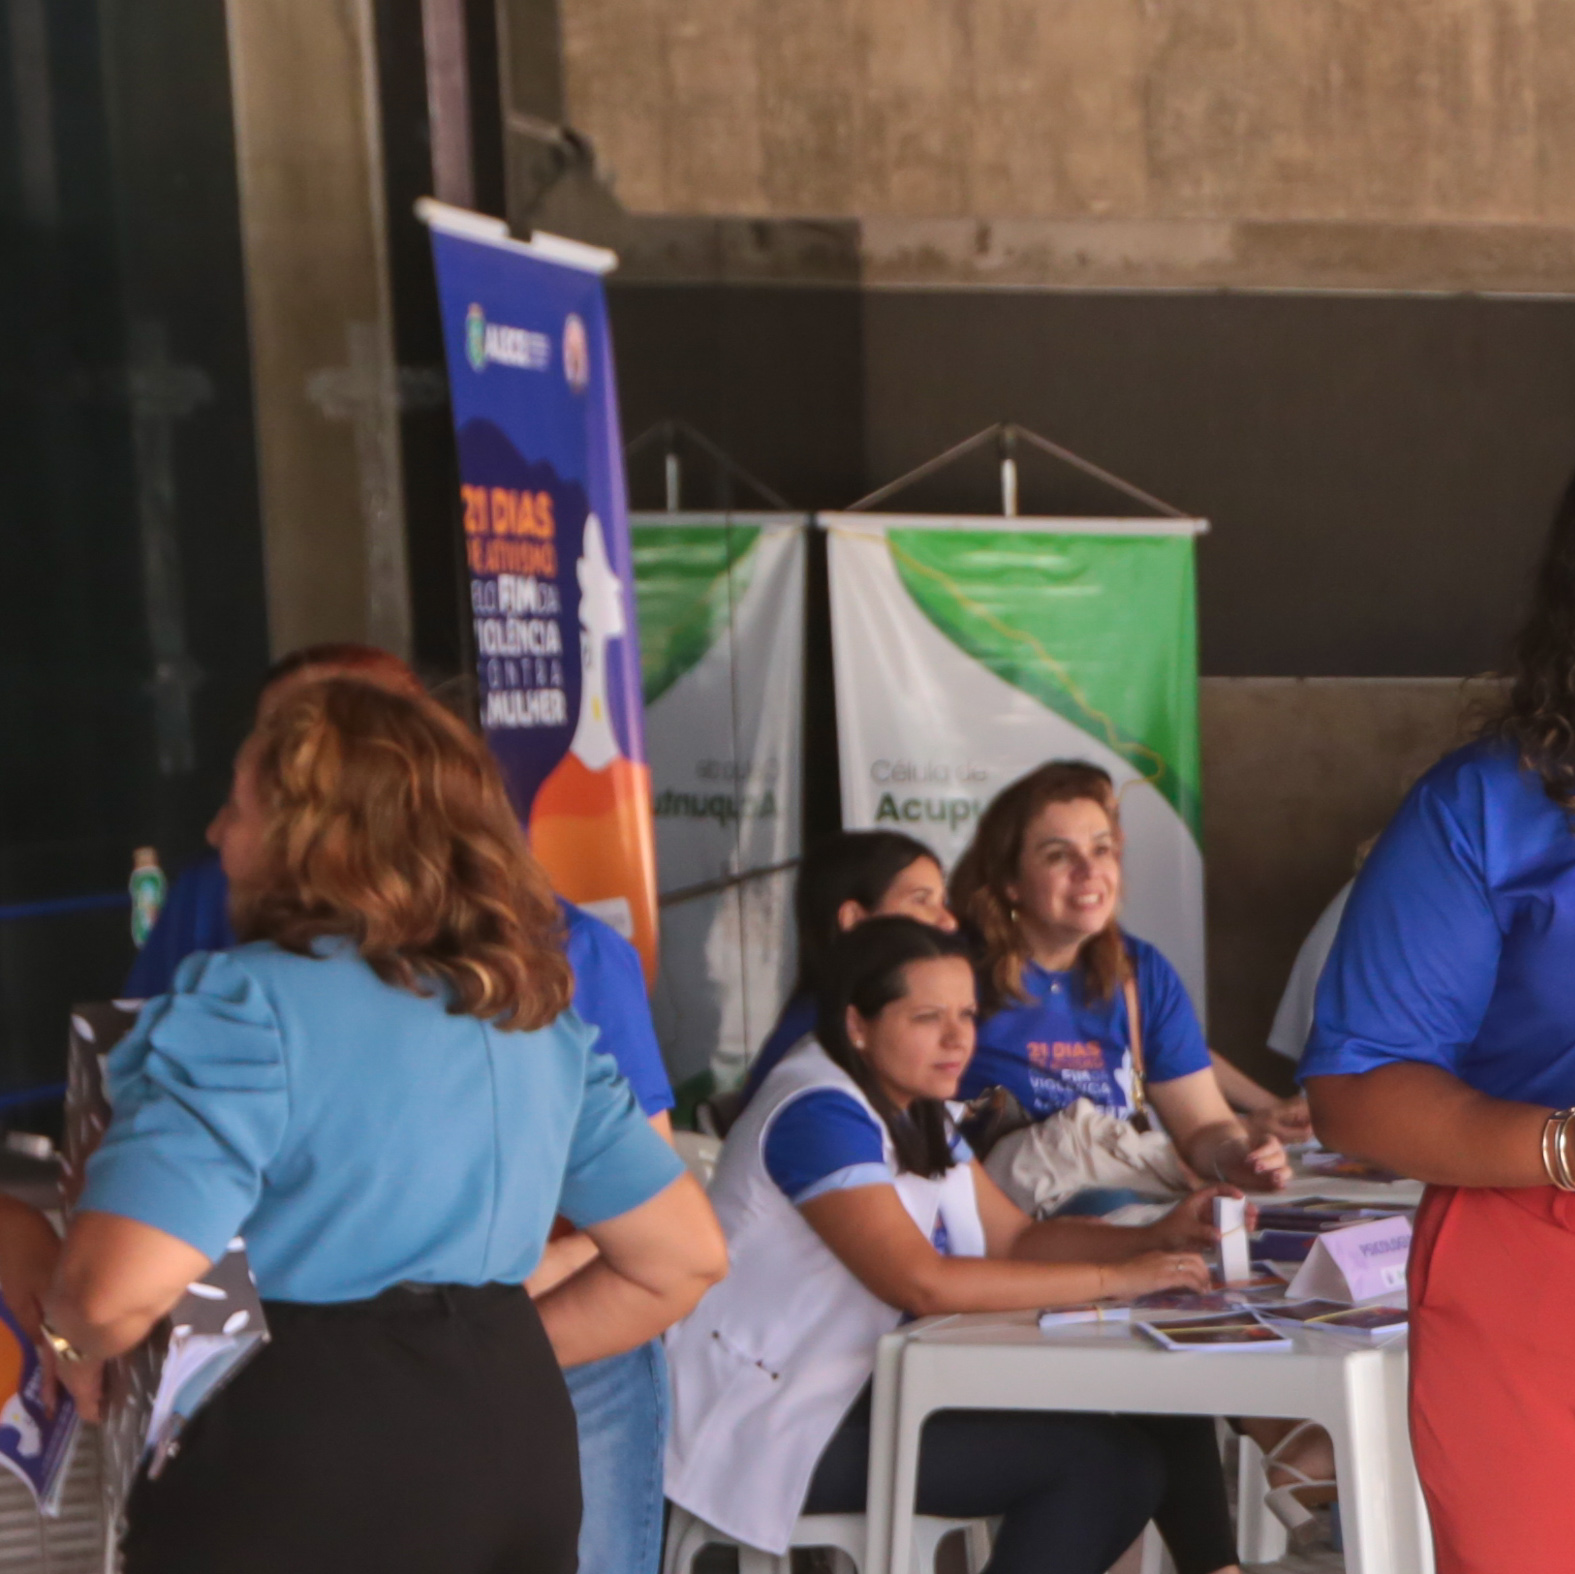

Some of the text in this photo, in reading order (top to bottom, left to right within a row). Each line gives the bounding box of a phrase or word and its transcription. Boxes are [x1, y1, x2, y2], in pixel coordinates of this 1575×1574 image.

[491, 487, 556, 539] DIAS
[471, 579, 498, 615] ELO
[499, 573, 538, 616] FIM
[479, 657, 565, 691] ONTRA
